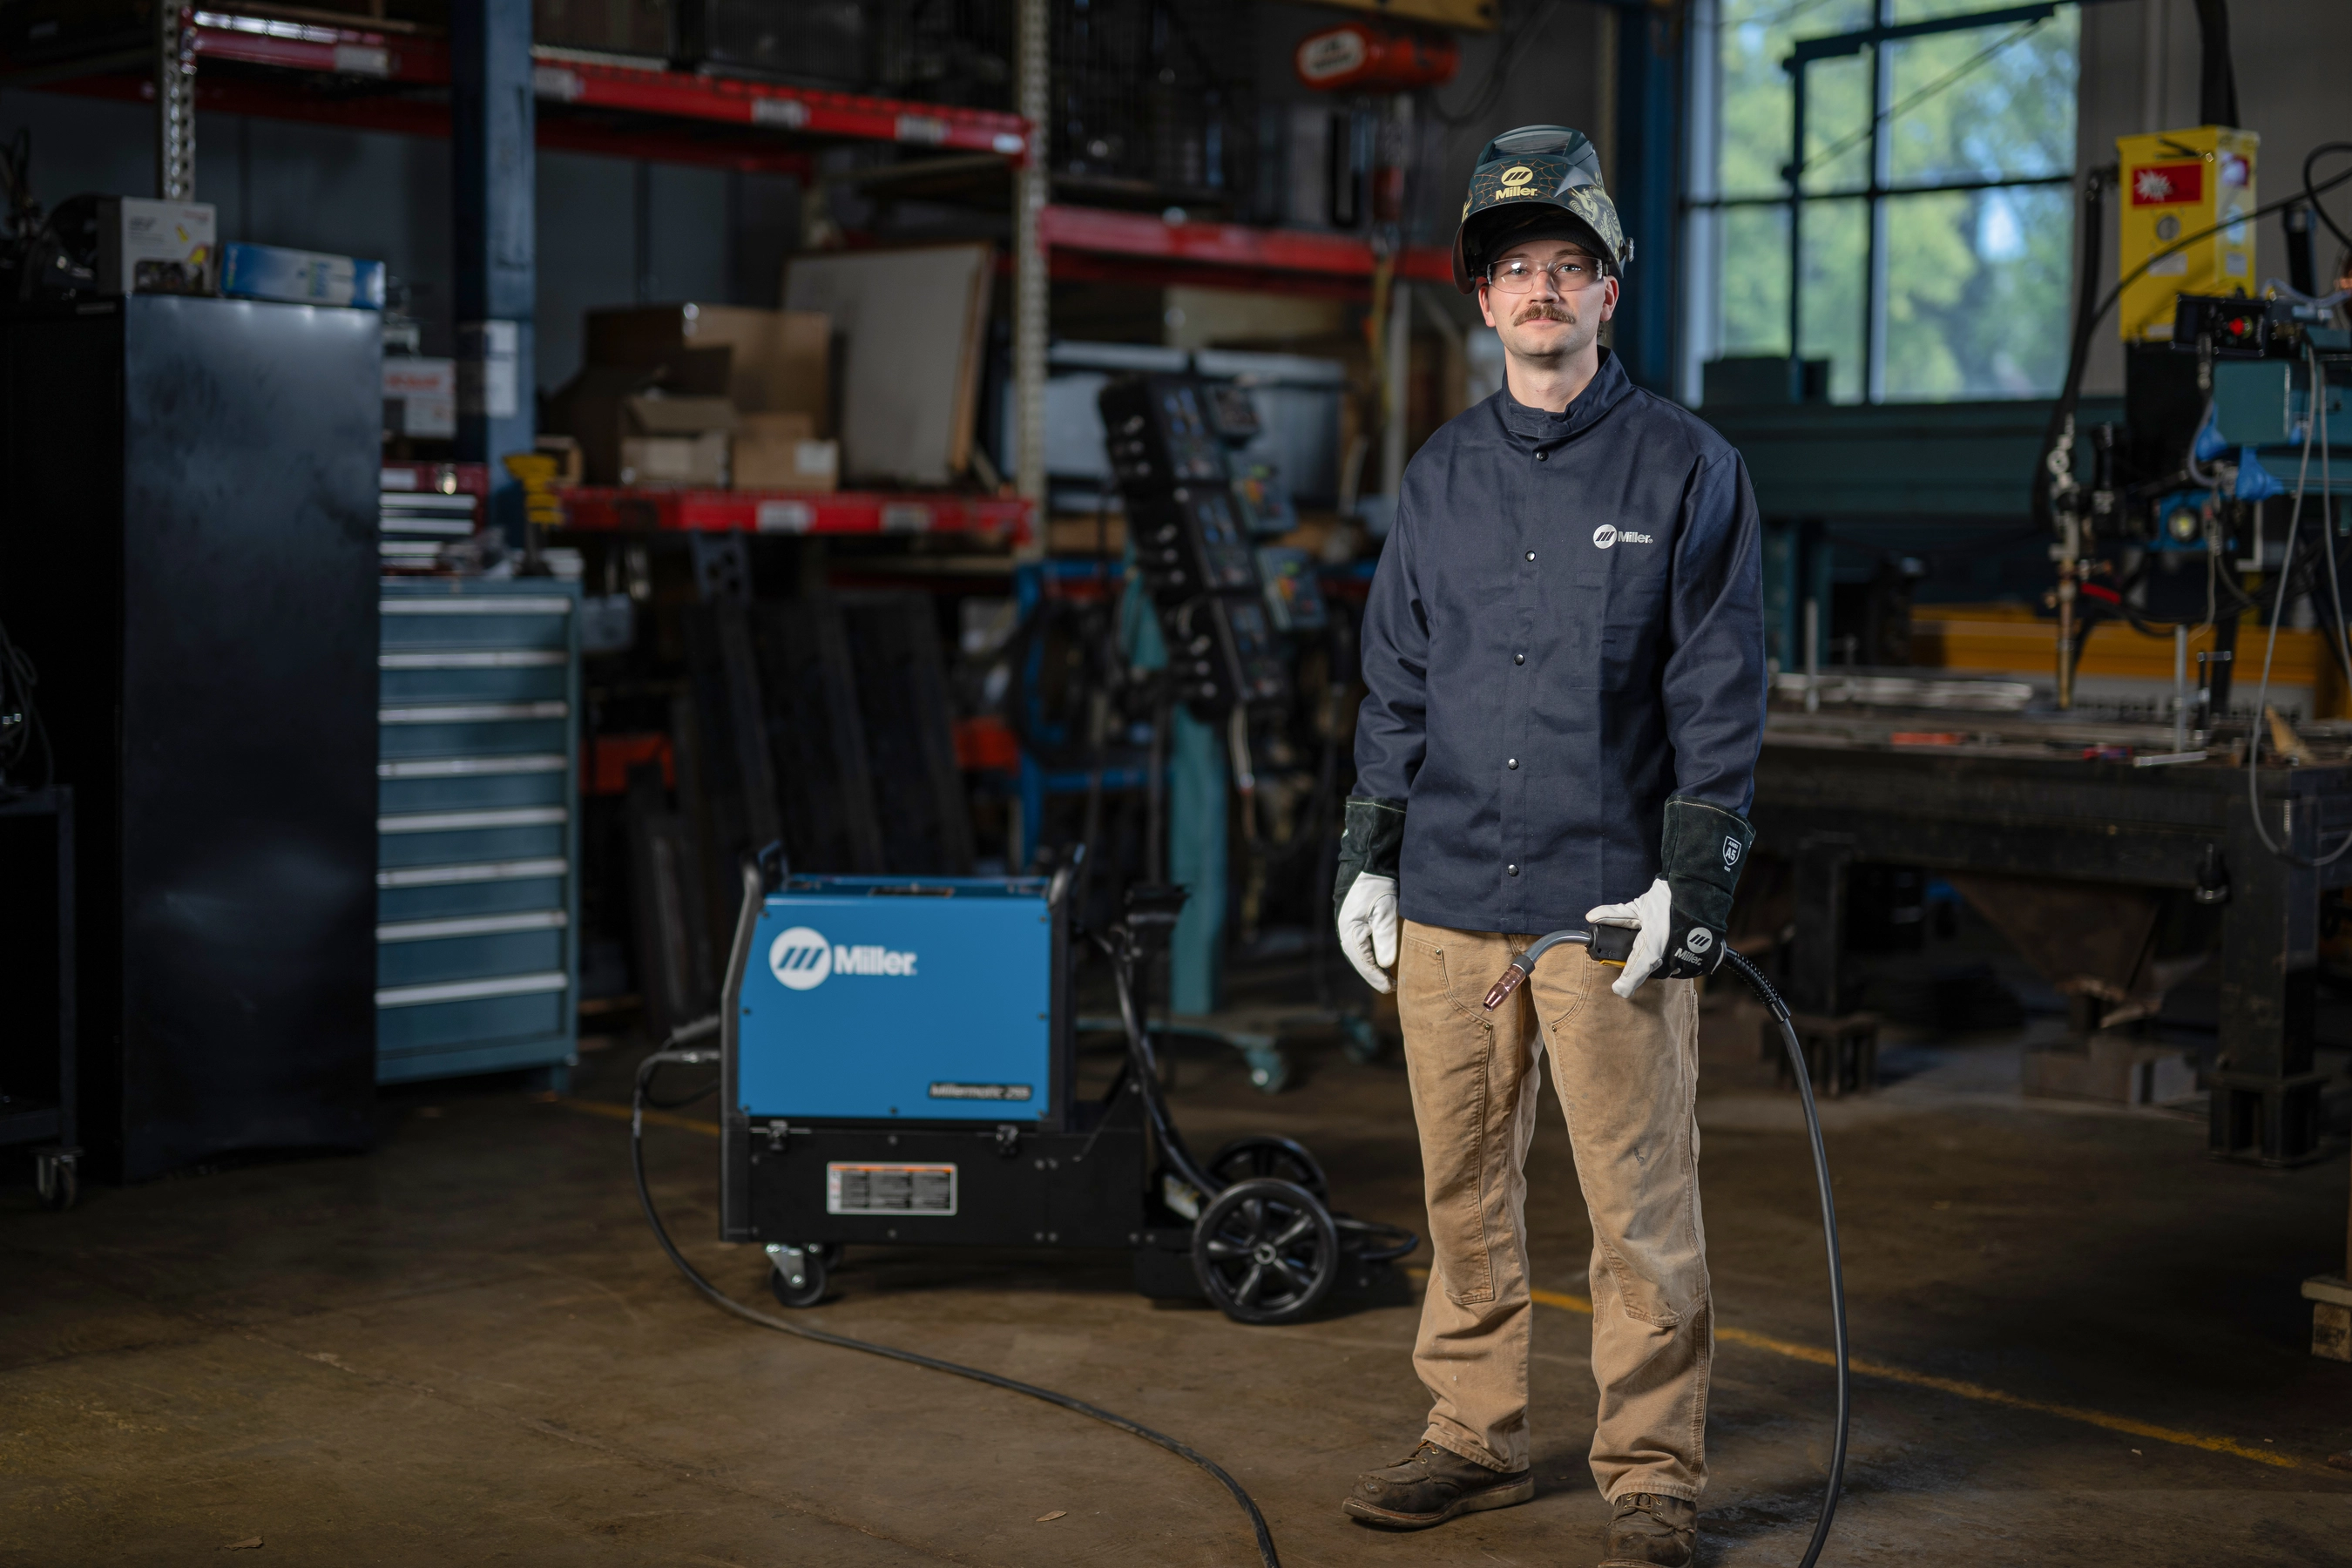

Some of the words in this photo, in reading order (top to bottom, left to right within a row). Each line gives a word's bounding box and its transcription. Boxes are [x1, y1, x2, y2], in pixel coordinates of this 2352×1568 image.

[1496, 186, 1538, 200] Miller
[1618, 531, 1652, 544] Miller
[1725, 847, 1737, 862] A5
[834, 944, 917, 977] Miller
[1674, 947, 1703, 966] Miller
